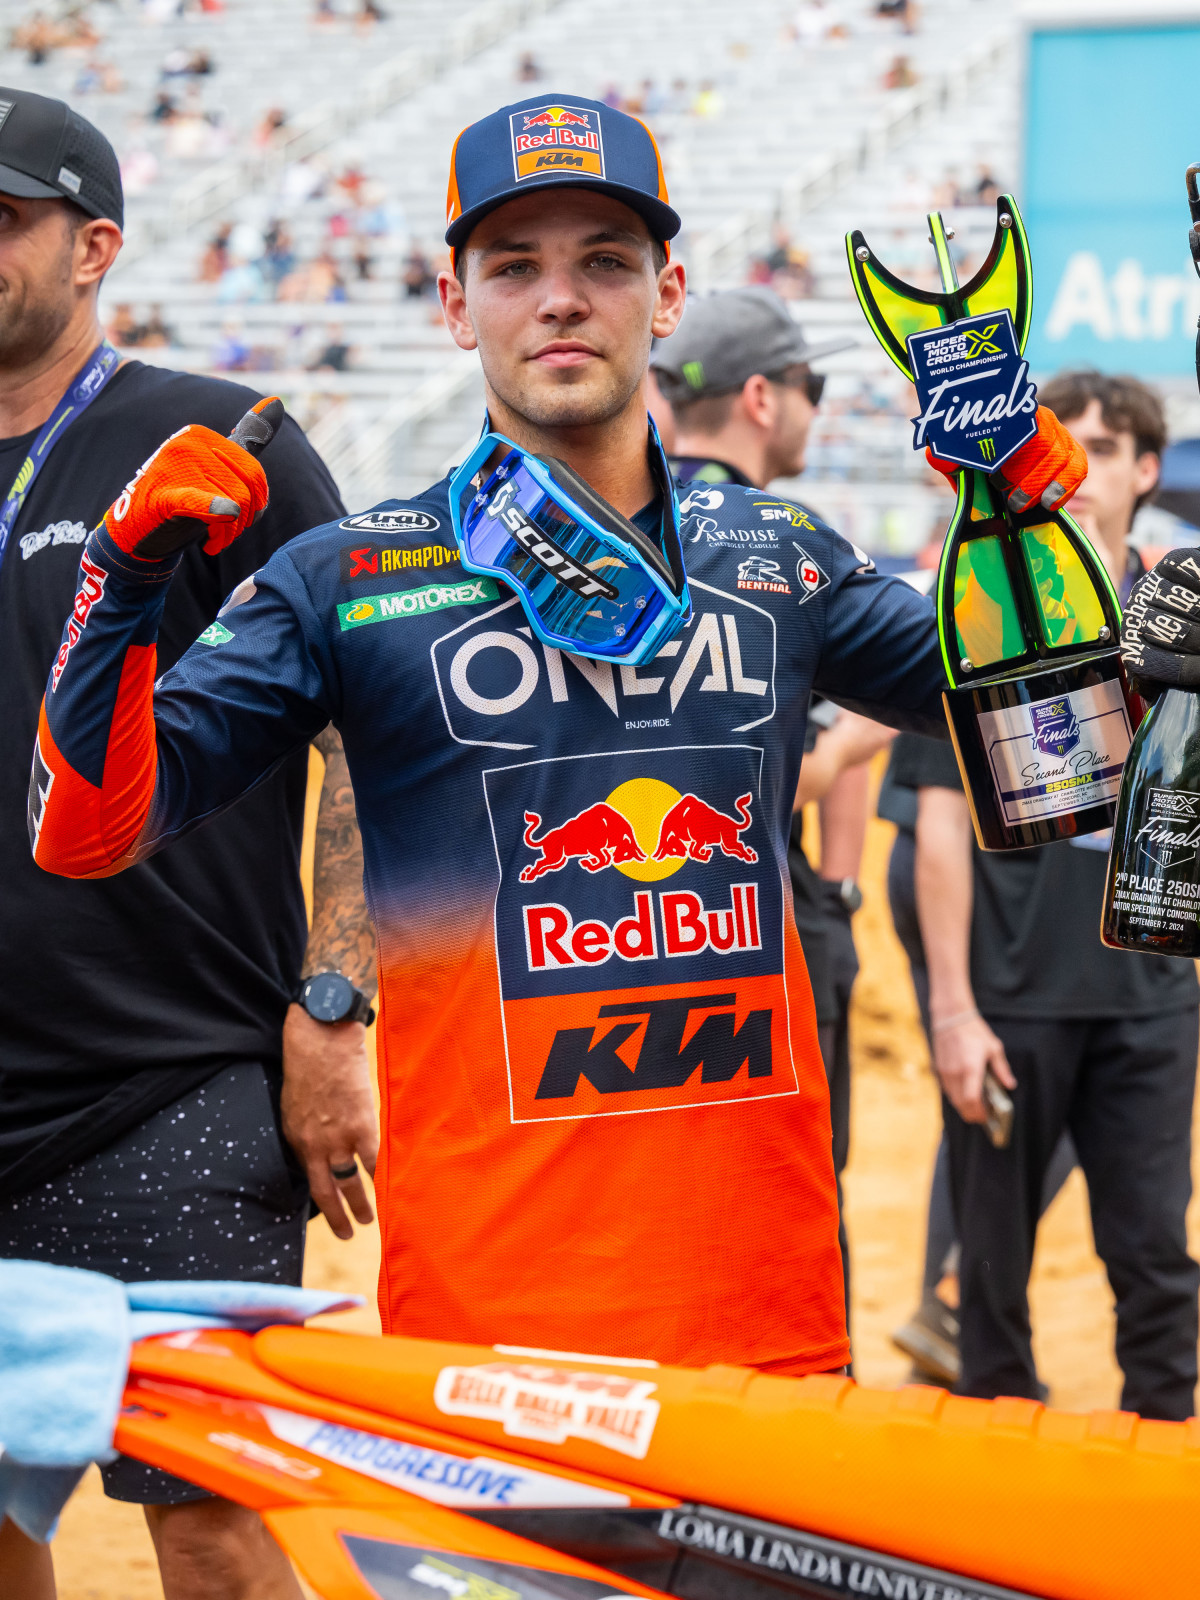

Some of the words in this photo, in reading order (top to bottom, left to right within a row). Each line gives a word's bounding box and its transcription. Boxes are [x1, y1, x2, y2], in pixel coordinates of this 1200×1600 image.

[516, 128, 558, 152] Red
[559, 128, 599, 150] Bull
[535, 152, 584, 167] KTM
[923, 334, 967, 351] SUPER
[928, 343, 966, 358] MOTO
[926, 350, 968, 366] CROSS
[930, 365, 955, 376] WORLD
[955, 352, 1008, 370] CHAMPIONSHIP
[916, 361, 1036, 446] Finals
[965, 428, 991, 438] FUELED
[992, 425, 1002, 433] BY
[352, 513, 426, 527] Arai
[680, 514, 779, 543] PARADISE
[501, 507, 610, 596] SCOTT
[737, 579, 792, 594] RENTHAL
[379, 582, 488, 616] MOTOREX
[625, 720, 650, 730] ENJOY
[1033, 715, 1079, 749] Finals
[1021, 761, 1067, 786] Second
[1069, 750, 1111, 775] Place
[1045, 773, 1094, 794] 250SMX
[1052, 799, 1079, 810] SEPTEMBER
[1153, 792, 1178, 800] SUPER
[1153, 797, 1177, 805] MOTO
[1115, 872, 1128, 887] 2ND
[1129, 874, 1165, 893] PLACE
[1115, 889, 1130, 900] ZMAX
[1130, 891, 1162, 904] DRAGWAY
[1162, 897, 1171, 906] AT
[1112, 901, 1130, 912] MOTOR
[1131, 903, 1166, 917] SPEEDWAY
[1166, 909, 1198, 922] CONCORD,
[522, 890, 658, 972] Red
[659, 882, 762, 958] Bull
[1129, 916, 1162, 929] SEPTEMBER
[1169, 922, 1184, 931] 2024
[534, 992, 773, 1100] KTM
[306, 1421, 526, 1504] PROGRESSIVE
[657, 1508, 745, 1559] LOMA
[750, 1534, 843, 1586] LINDA
